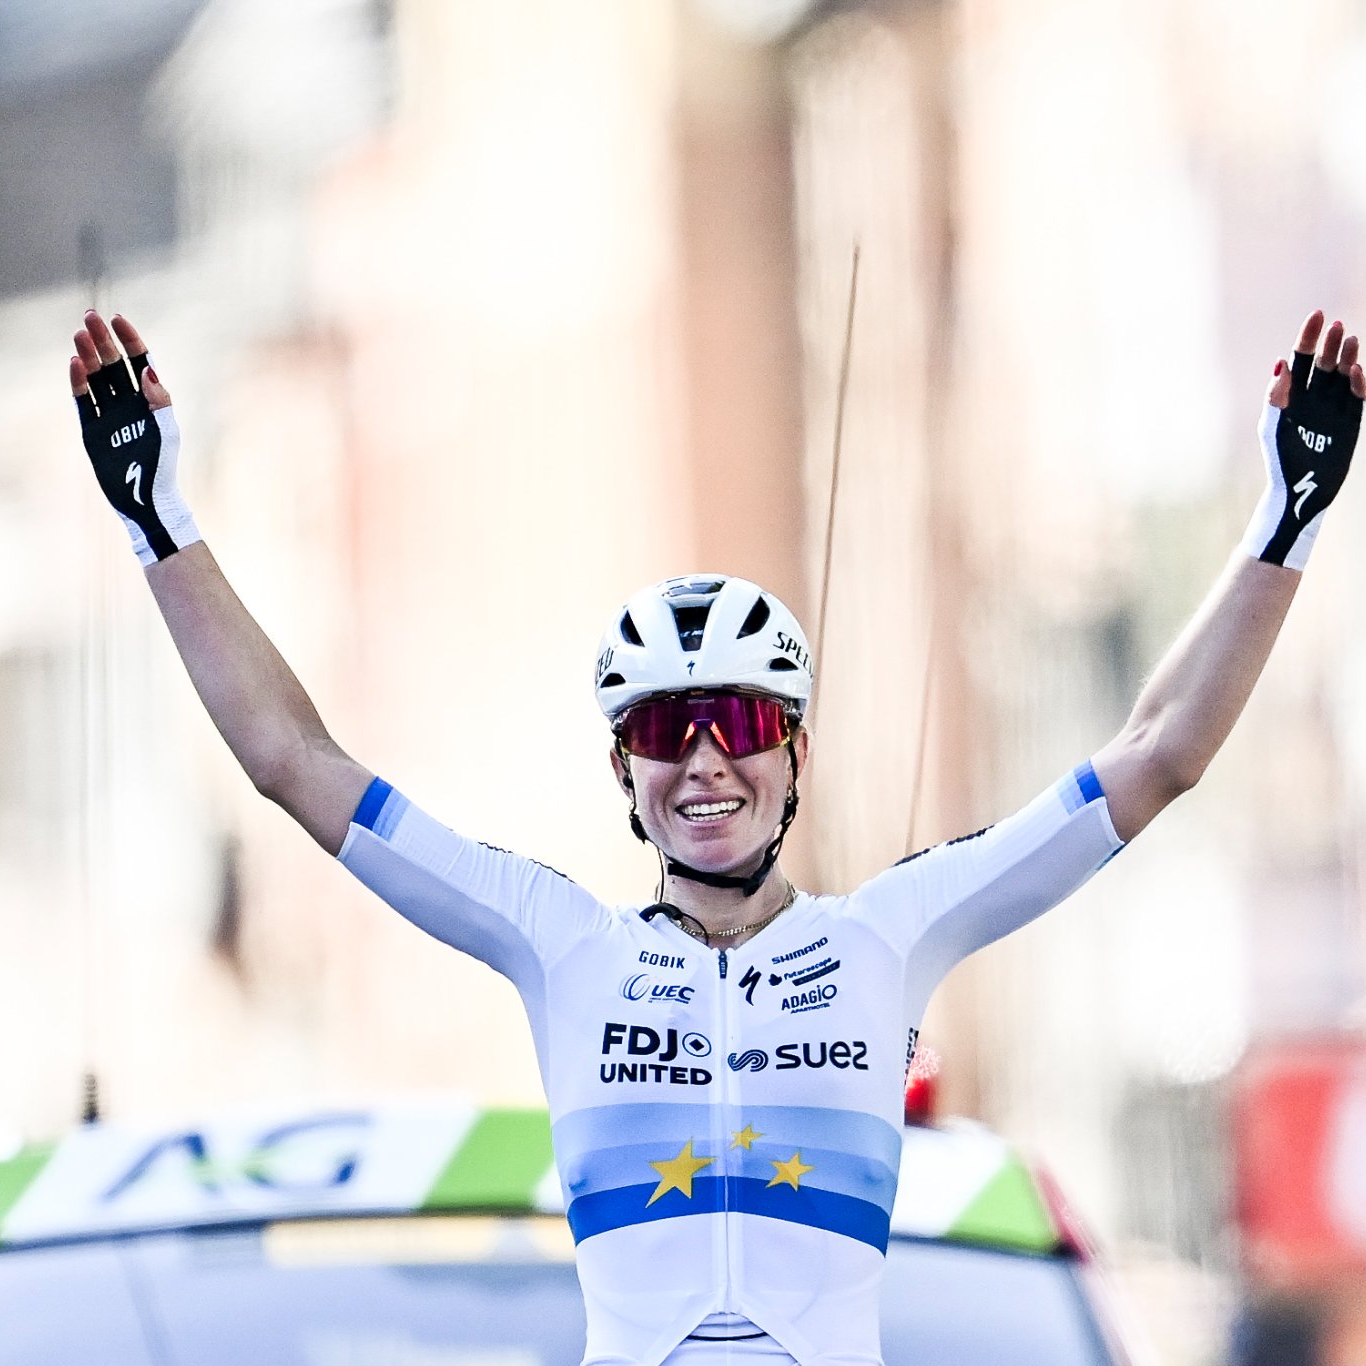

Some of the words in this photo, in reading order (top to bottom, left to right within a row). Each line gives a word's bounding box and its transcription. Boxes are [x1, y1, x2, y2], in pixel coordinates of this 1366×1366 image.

[111, 419, 146, 448] OBIK
[638, 950, 686, 970] GOBIK
[771, 936, 829, 965] SHIMANO
[651, 984, 696, 1001] UEC
[601, 1022, 678, 1062] FDJ
[600, 1062, 713, 1086] UNITED
